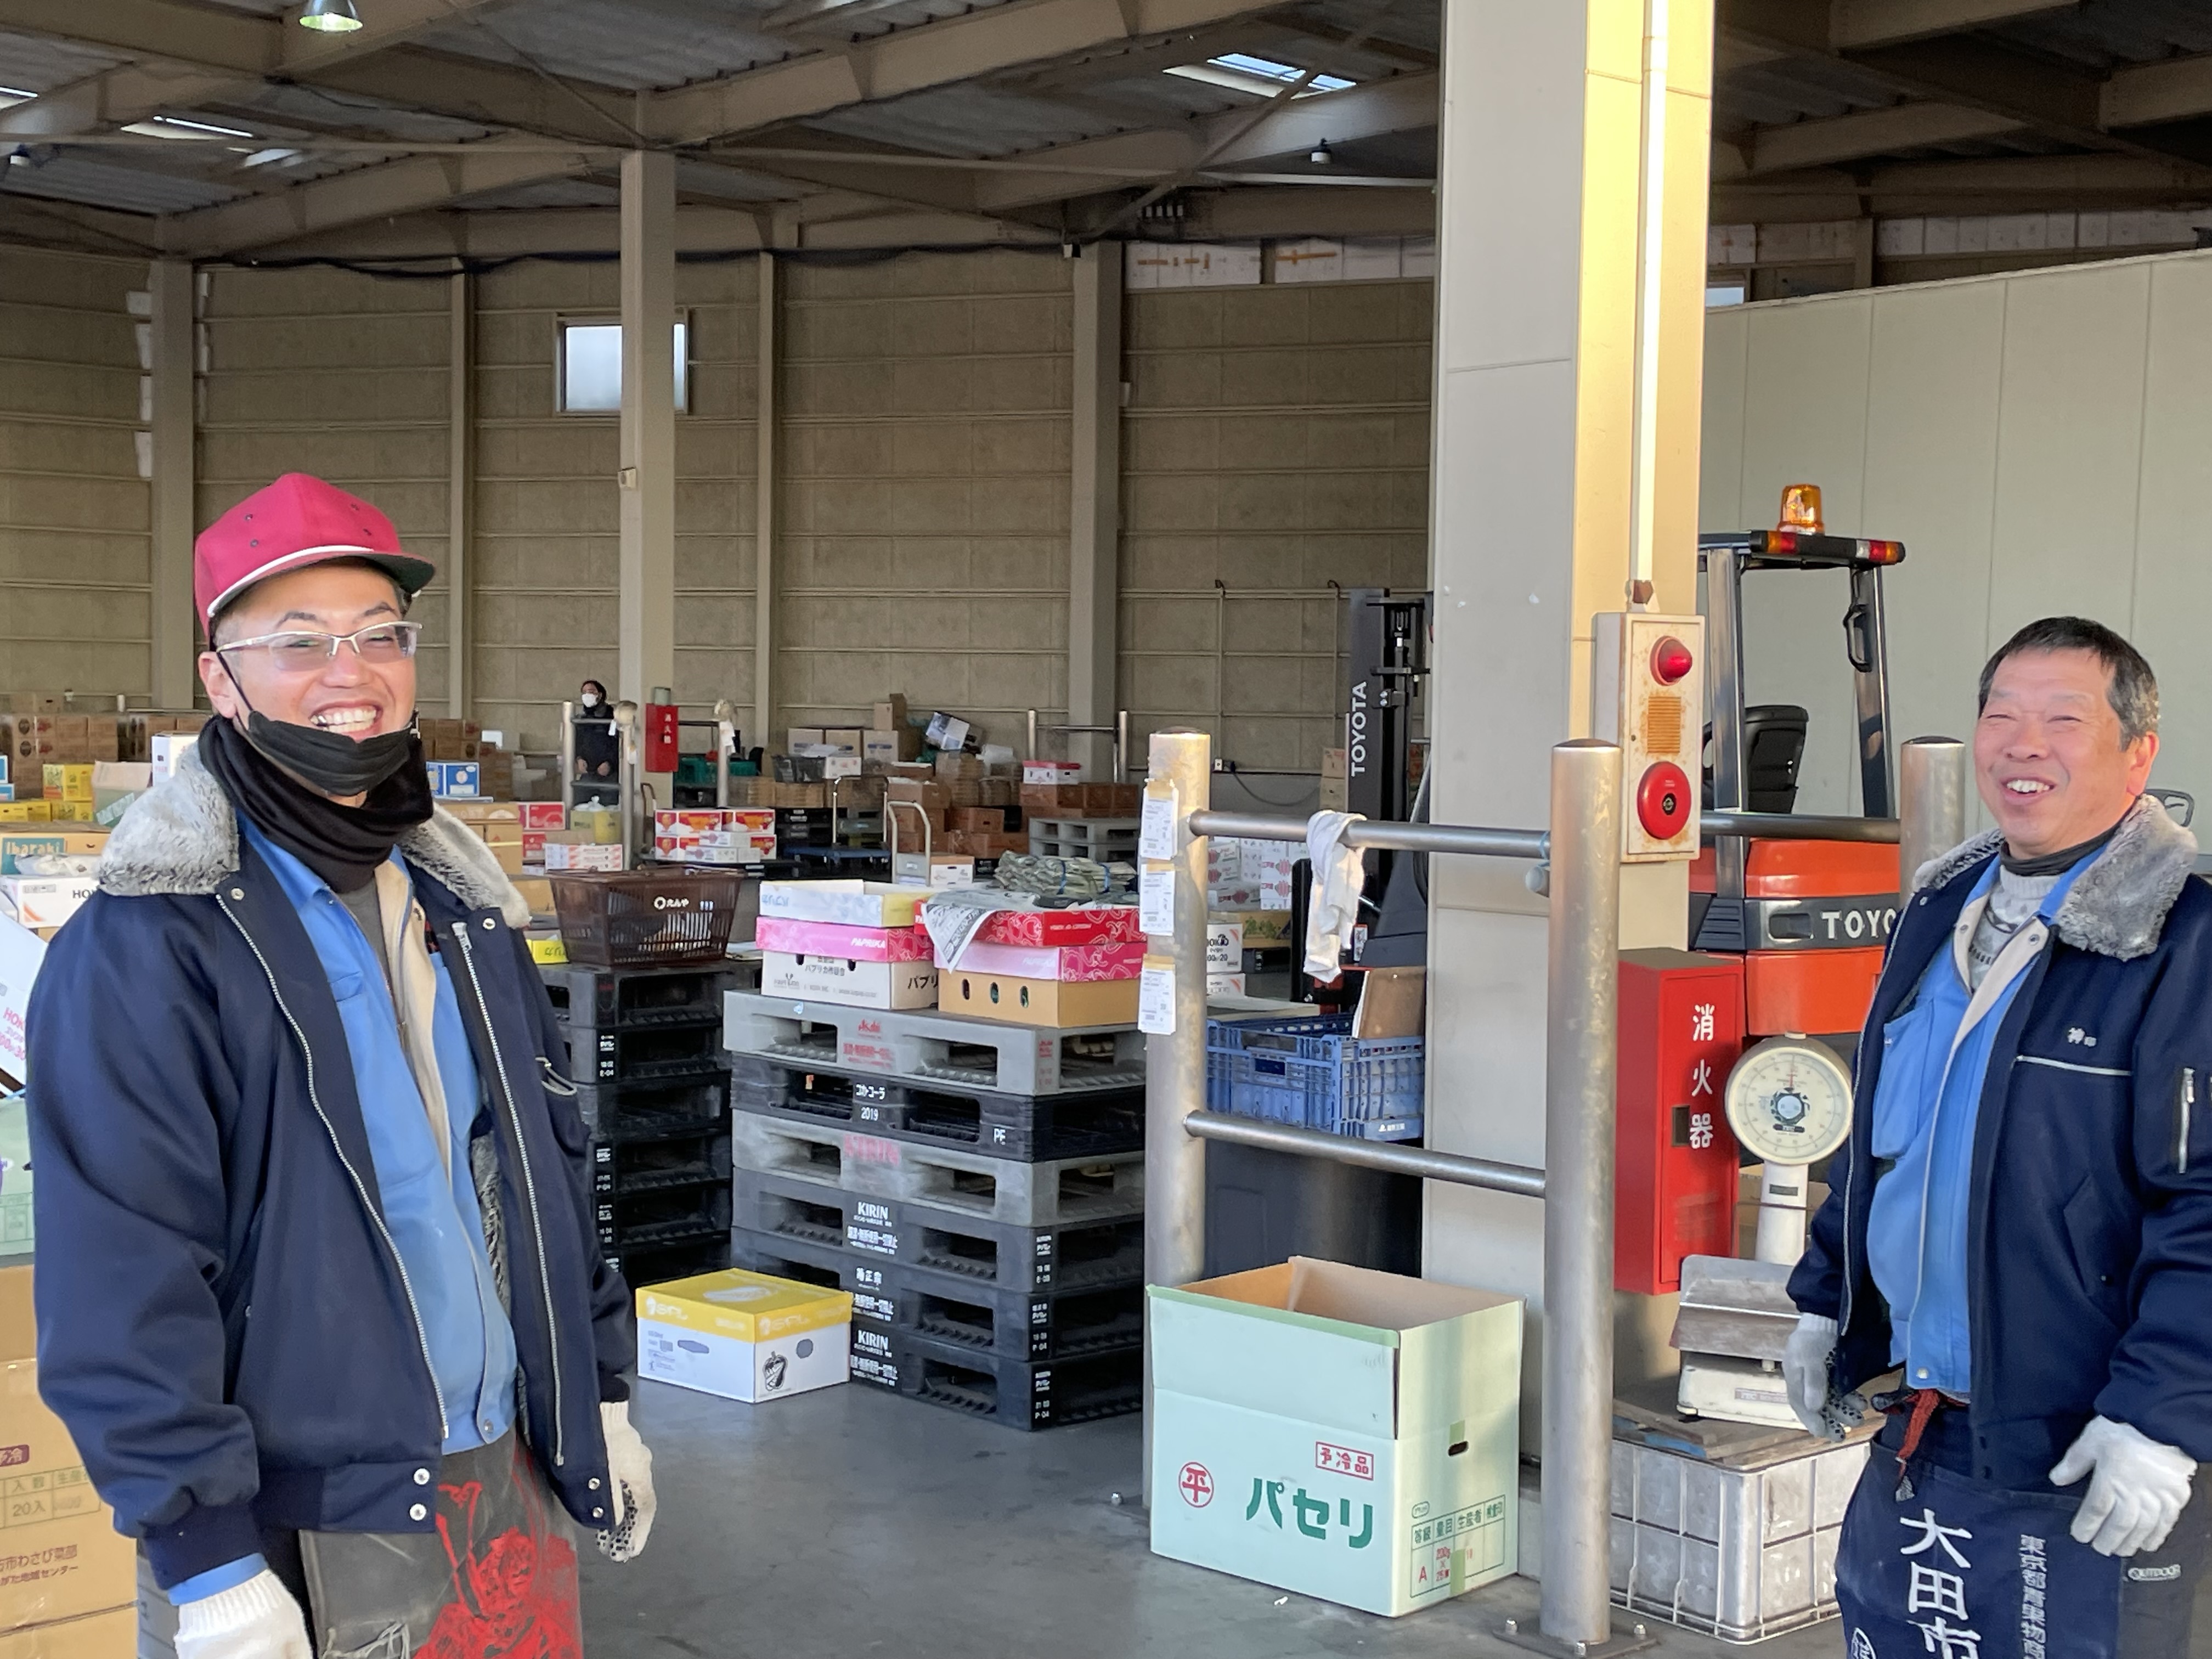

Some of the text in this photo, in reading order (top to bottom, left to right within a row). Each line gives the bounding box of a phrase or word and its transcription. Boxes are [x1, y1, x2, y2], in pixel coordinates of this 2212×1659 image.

[1351, 681, 1367, 776] TOYOTA
[851, 937, 886, 949] PAPRIKA
[1690, 1003, 1715, 1148] 消火器
[861, 1107, 878, 1121] 2019
[858, 1201, 888, 1220] KIRIN
[858, 1329, 889, 1351] KIRIN
[1320, 1447, 1369, 1475] 予冷品
[1182, 1467, 1211, 1503] 平
[1246, 1478, 1373, 1549] パセリ
[1419, 1565, 1427, 1583] A
